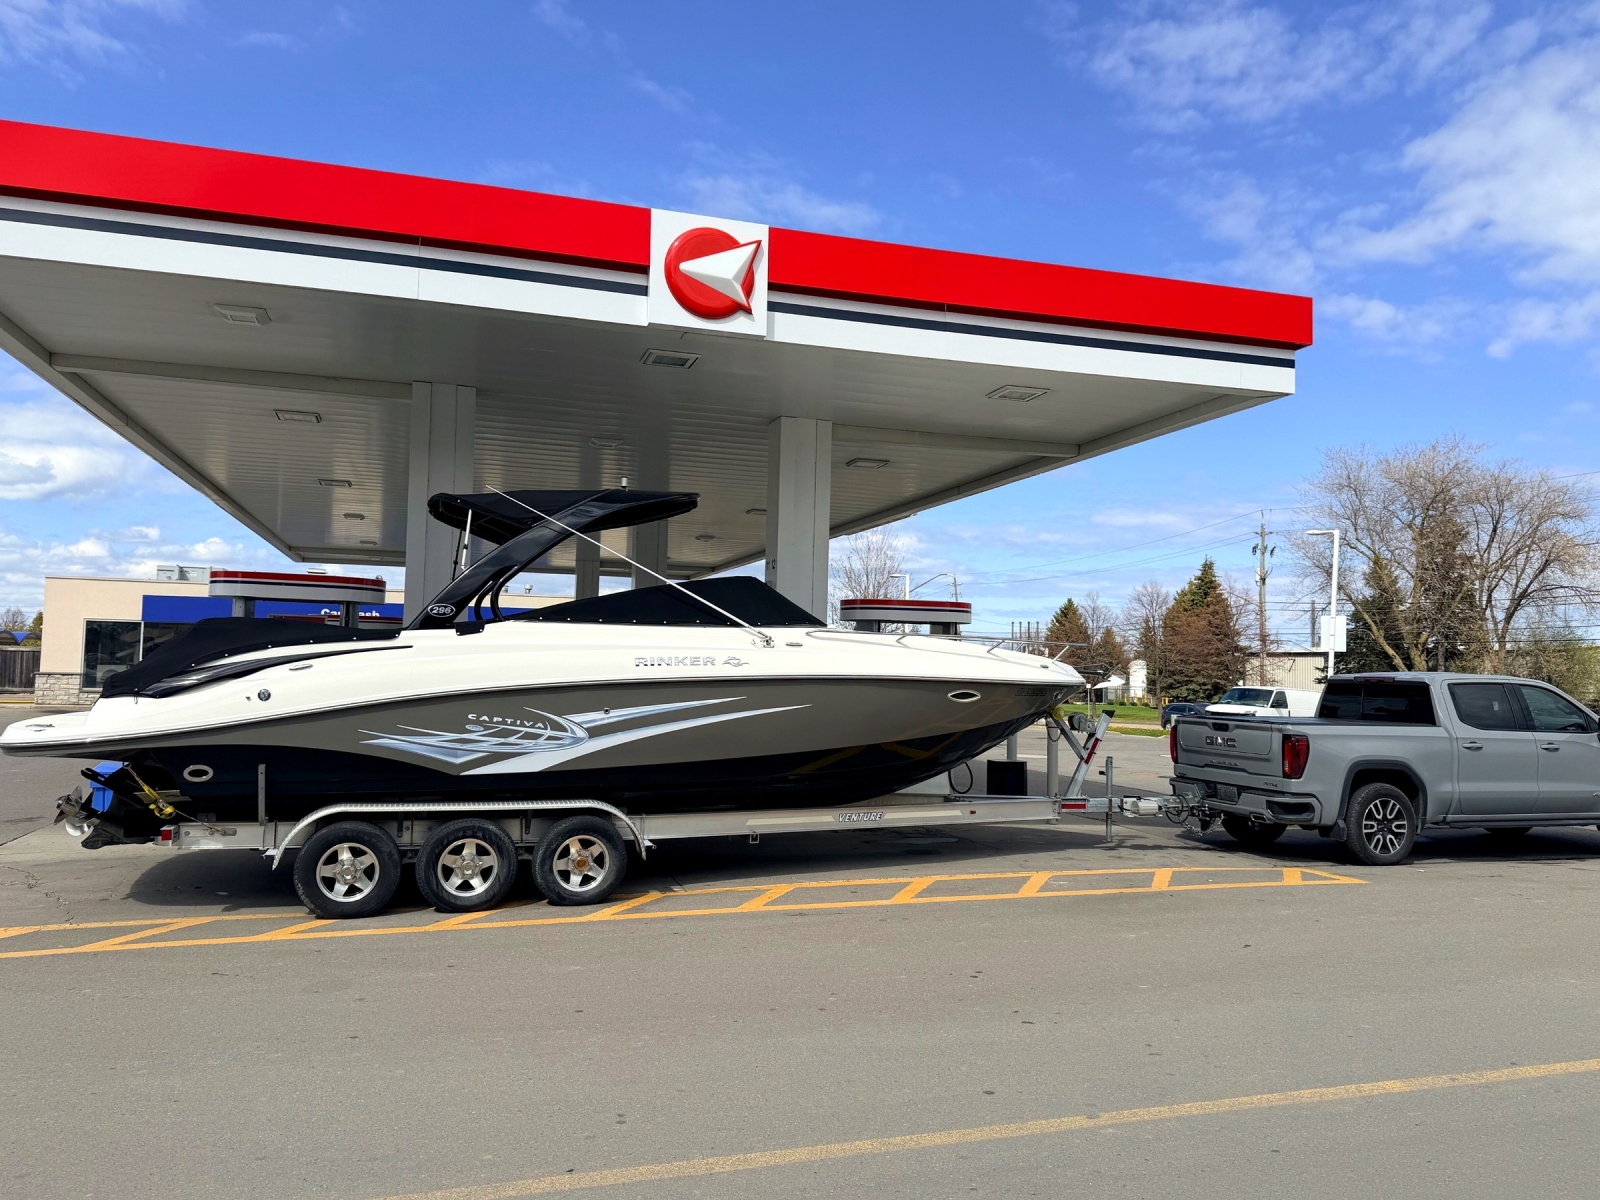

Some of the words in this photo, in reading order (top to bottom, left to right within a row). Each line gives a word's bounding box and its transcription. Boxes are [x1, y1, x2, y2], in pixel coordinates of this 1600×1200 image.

[432, 606, 452, 614] 296
[634, 656, 716, 667] RINKER
[467, 713, 545, 729] CAPTIVA
[1205, 735, 1238, 749] GMC
[838, 811, 884, 823] VENTURE
